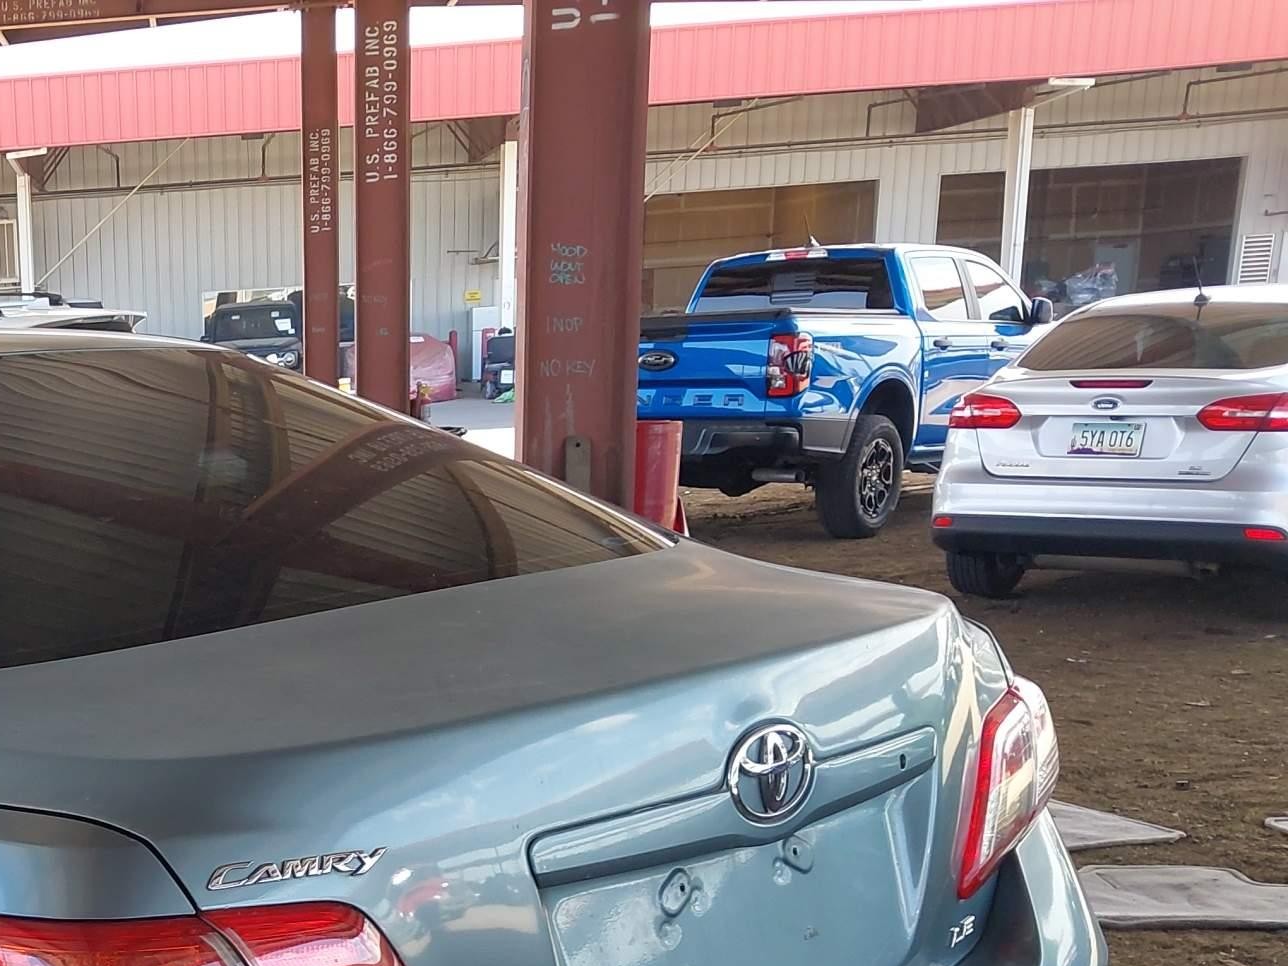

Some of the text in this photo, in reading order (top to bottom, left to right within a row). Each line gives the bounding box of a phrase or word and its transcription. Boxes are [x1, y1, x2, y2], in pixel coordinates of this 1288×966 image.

[365, 66, 380, 138] PREFAB
[383, 20, 398, 180] 1-866-799-0969
[309, 128, 320, 233] U.S. PREFAB INC.
[321, 128, 331, 231] 1-866-799-0969
[365, 148, 380, 183] U.S.
[550, 243, 588, 257] HOOD
[1080, 430, 1105, 447] 5YA
[206, 846, 389, 891] CAMRY
